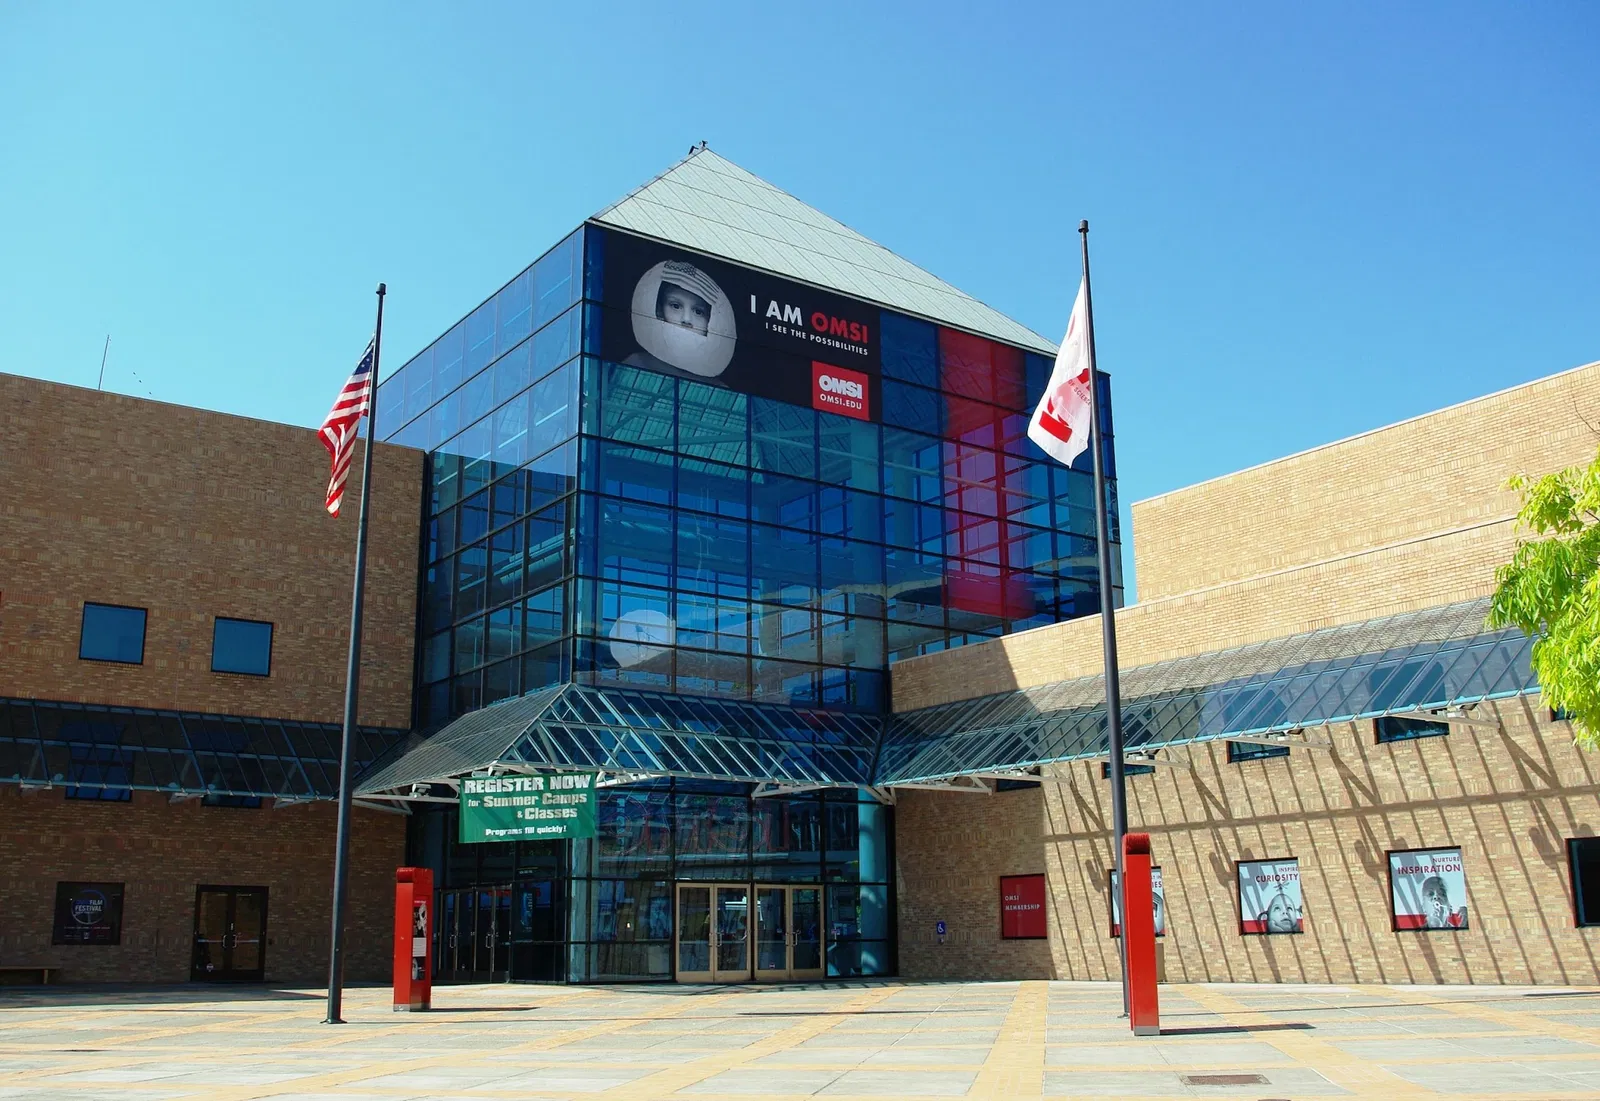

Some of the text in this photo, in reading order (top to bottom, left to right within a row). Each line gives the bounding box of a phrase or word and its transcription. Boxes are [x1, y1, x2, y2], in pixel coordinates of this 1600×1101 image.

[751, 295, 868, 344] I AM OMSI
[772, 324, 787, 335] SEE
[791, 329, 806, 340] THE
[810, 334, 868, 356] POSSIBILITIES
[818, 374, 863, 400] OMSI
[820, 393, 862, 410] OMSI.EDU
[464, 775, 592, 793] REGISTER NOW
[468, 793, 587, 807] for Summer Camps
[524, 808, 578, 820] Classes
[485, 827, 522, 836] Programs
[537, 825, 567, 835] quickly!
[1397, 864, 1461, 875] INSPIRATION
[1255, 873, 1298, 883] CURIOSITY
[1005, 903, 1040, 911] MEMBERSHIP
